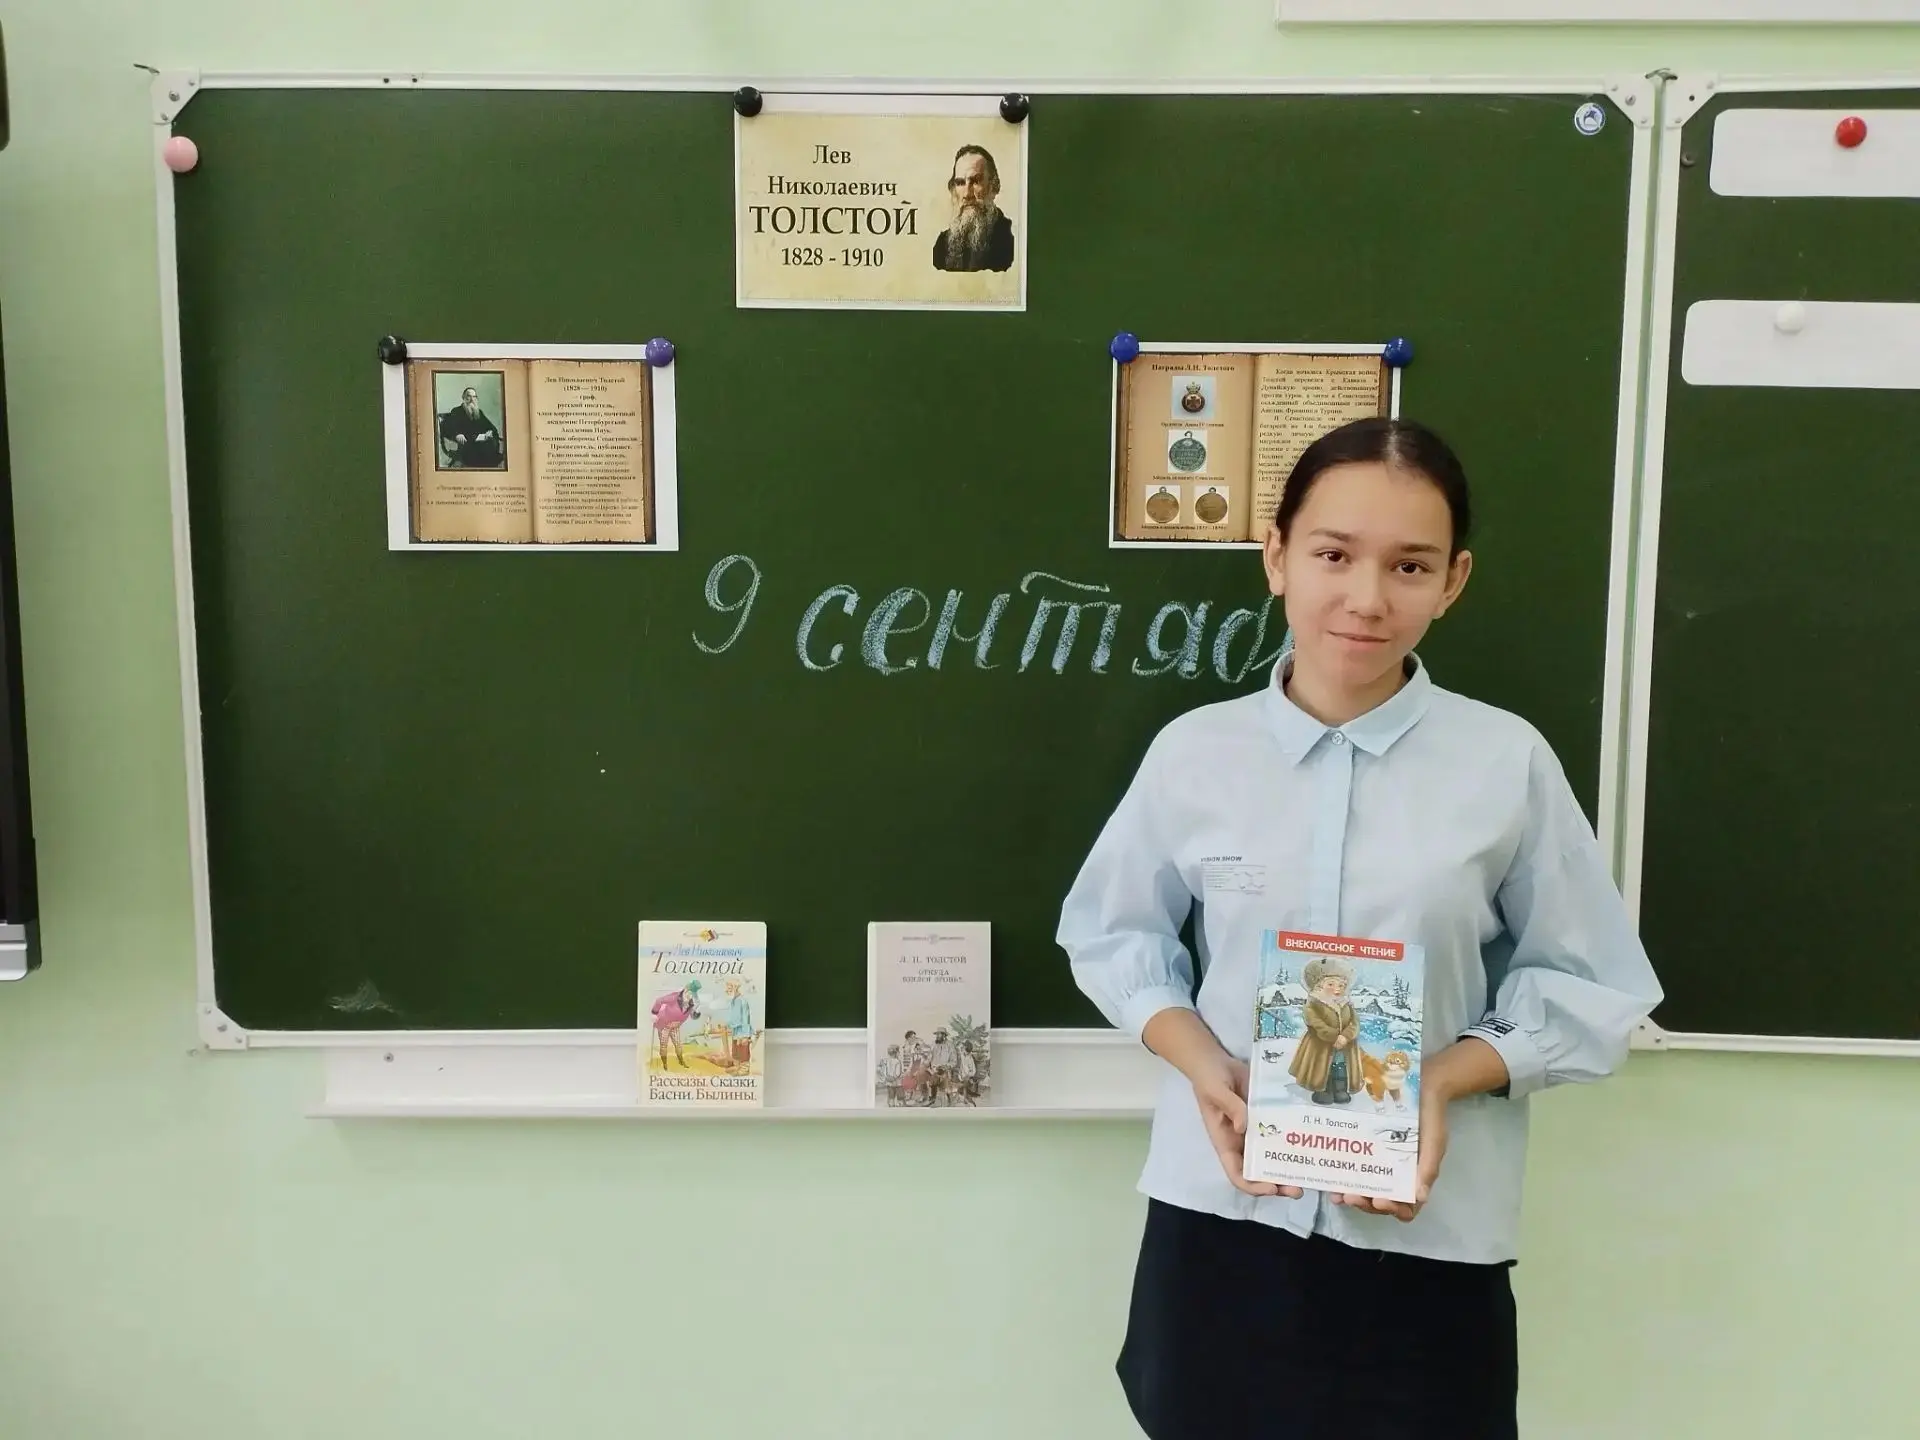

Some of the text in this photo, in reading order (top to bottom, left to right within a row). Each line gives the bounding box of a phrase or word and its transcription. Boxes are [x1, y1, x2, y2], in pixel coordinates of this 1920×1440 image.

[813, 145, 851, 164] Лев
[767, 175, 897, 196] Николаевич
[749, 200, 918, 235] ТОЛСТОЙ
[781, 248, 823, 266] 1828
[841, 248, 884, 267] 1910
[691, 554, 1296, 685] 9 сентяб
[1285, 938, 1397, 958] ВНЕКЛАССНОЕ ЧТЕНИЕ
[651, 949, 744, 975] Толстой
[710, 1075, 758, 1088] Сказки.
[696, 1088, 757, 1101] Былины.
[1325, 1118, 1359, 1130] Толстой
[1286, 1131, 1374, 1157] ФИЛИПОК
[1264, 1150, 1316, 1166] РАССКАЗЫ,
[1361, 1164, 1393, 1176] БАСНИ
